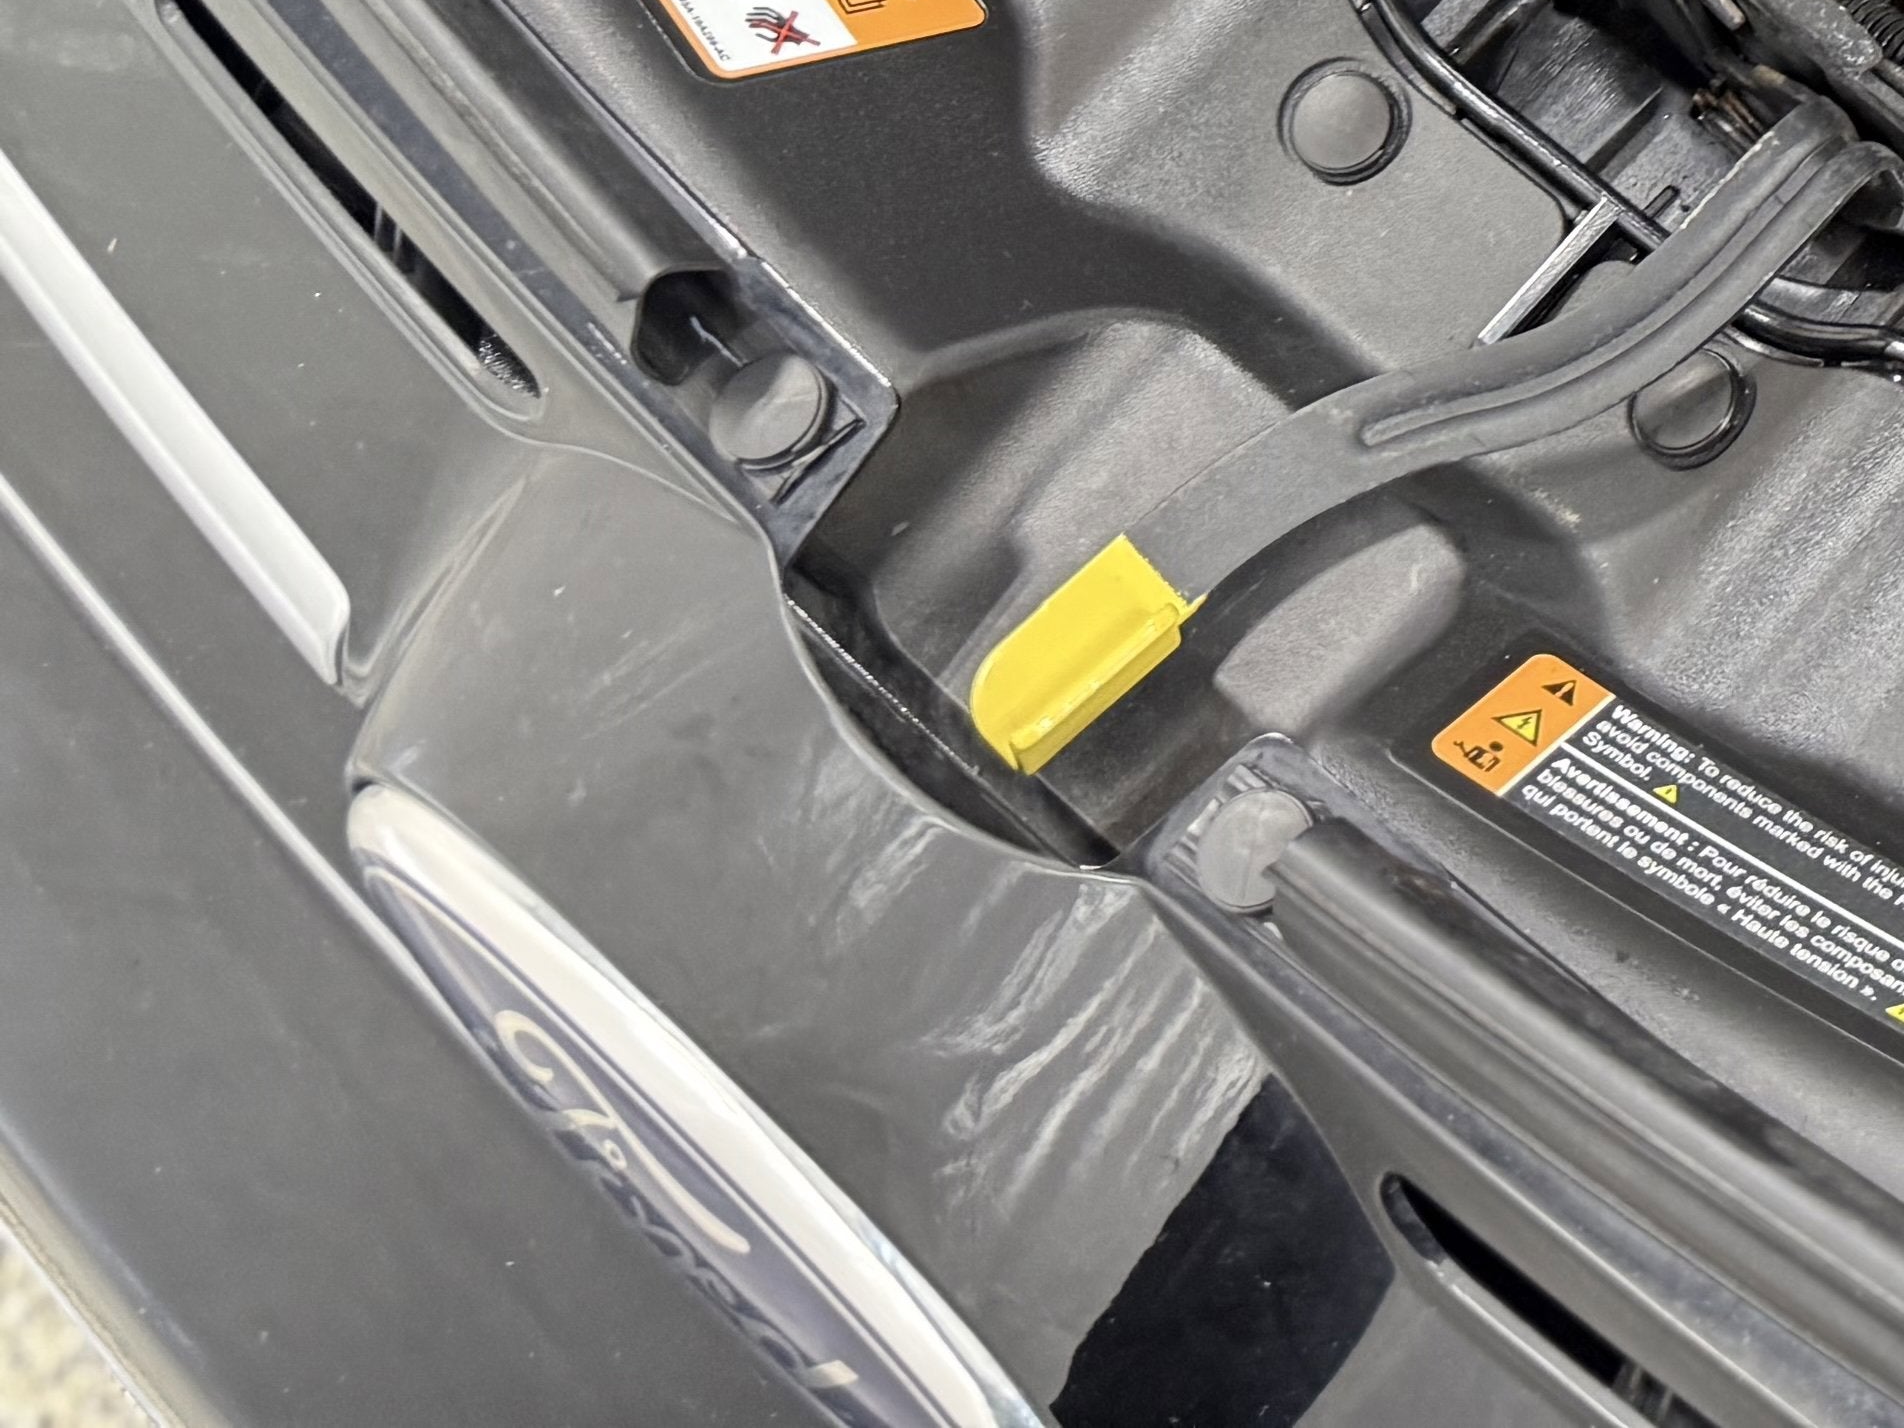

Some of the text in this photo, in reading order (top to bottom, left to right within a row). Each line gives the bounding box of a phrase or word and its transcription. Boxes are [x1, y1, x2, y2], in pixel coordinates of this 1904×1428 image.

[1582, 731, 1653, 781] Symbol.
[1595, 720, 1650, 755] avoid
[1645, 751, 1753, 819] components
[1751, 815, 1825, 860] marked
[1823, 854, 1862, 883] with
[1861, 876, 1894, 900] the
[1611, 704, 1696, 764] Warning:
[1697, 756, 1720, 778] To
[1718, 774, 1783, 815] reduce
[1782, 809, 1814, 833] the
[1813, 829, 1849, 854] risk
[1849, 850, 1875, 866] of
[1521, 784, 1557, 808] qui
[1548, 803, 1620, 849] portent
[1615, 840, 1638, 860] le
[1636, 855, 1716, 906] symbole
[1730, 908, 1790, 950] Haute
[1789, 942, 1860, 989] tension
[1536, 768, 1625, 829] blessures
[1623, 824, 1651, 845] ou
[1649, 840, 1677, 861] de
[1675, 856, 1723, 891] mort,
[1725, 885, 1782, 920] éviter
[1778, 914, 1810, 939] les
[1548, 757, 1690, 846] Avertissement
[1697, 845, 1748, 878] Pour
[1744, 874, 1811, 918] réduire
[1810, 910, 1832, 929] le
[1830, 924, 1891, 963] risque
